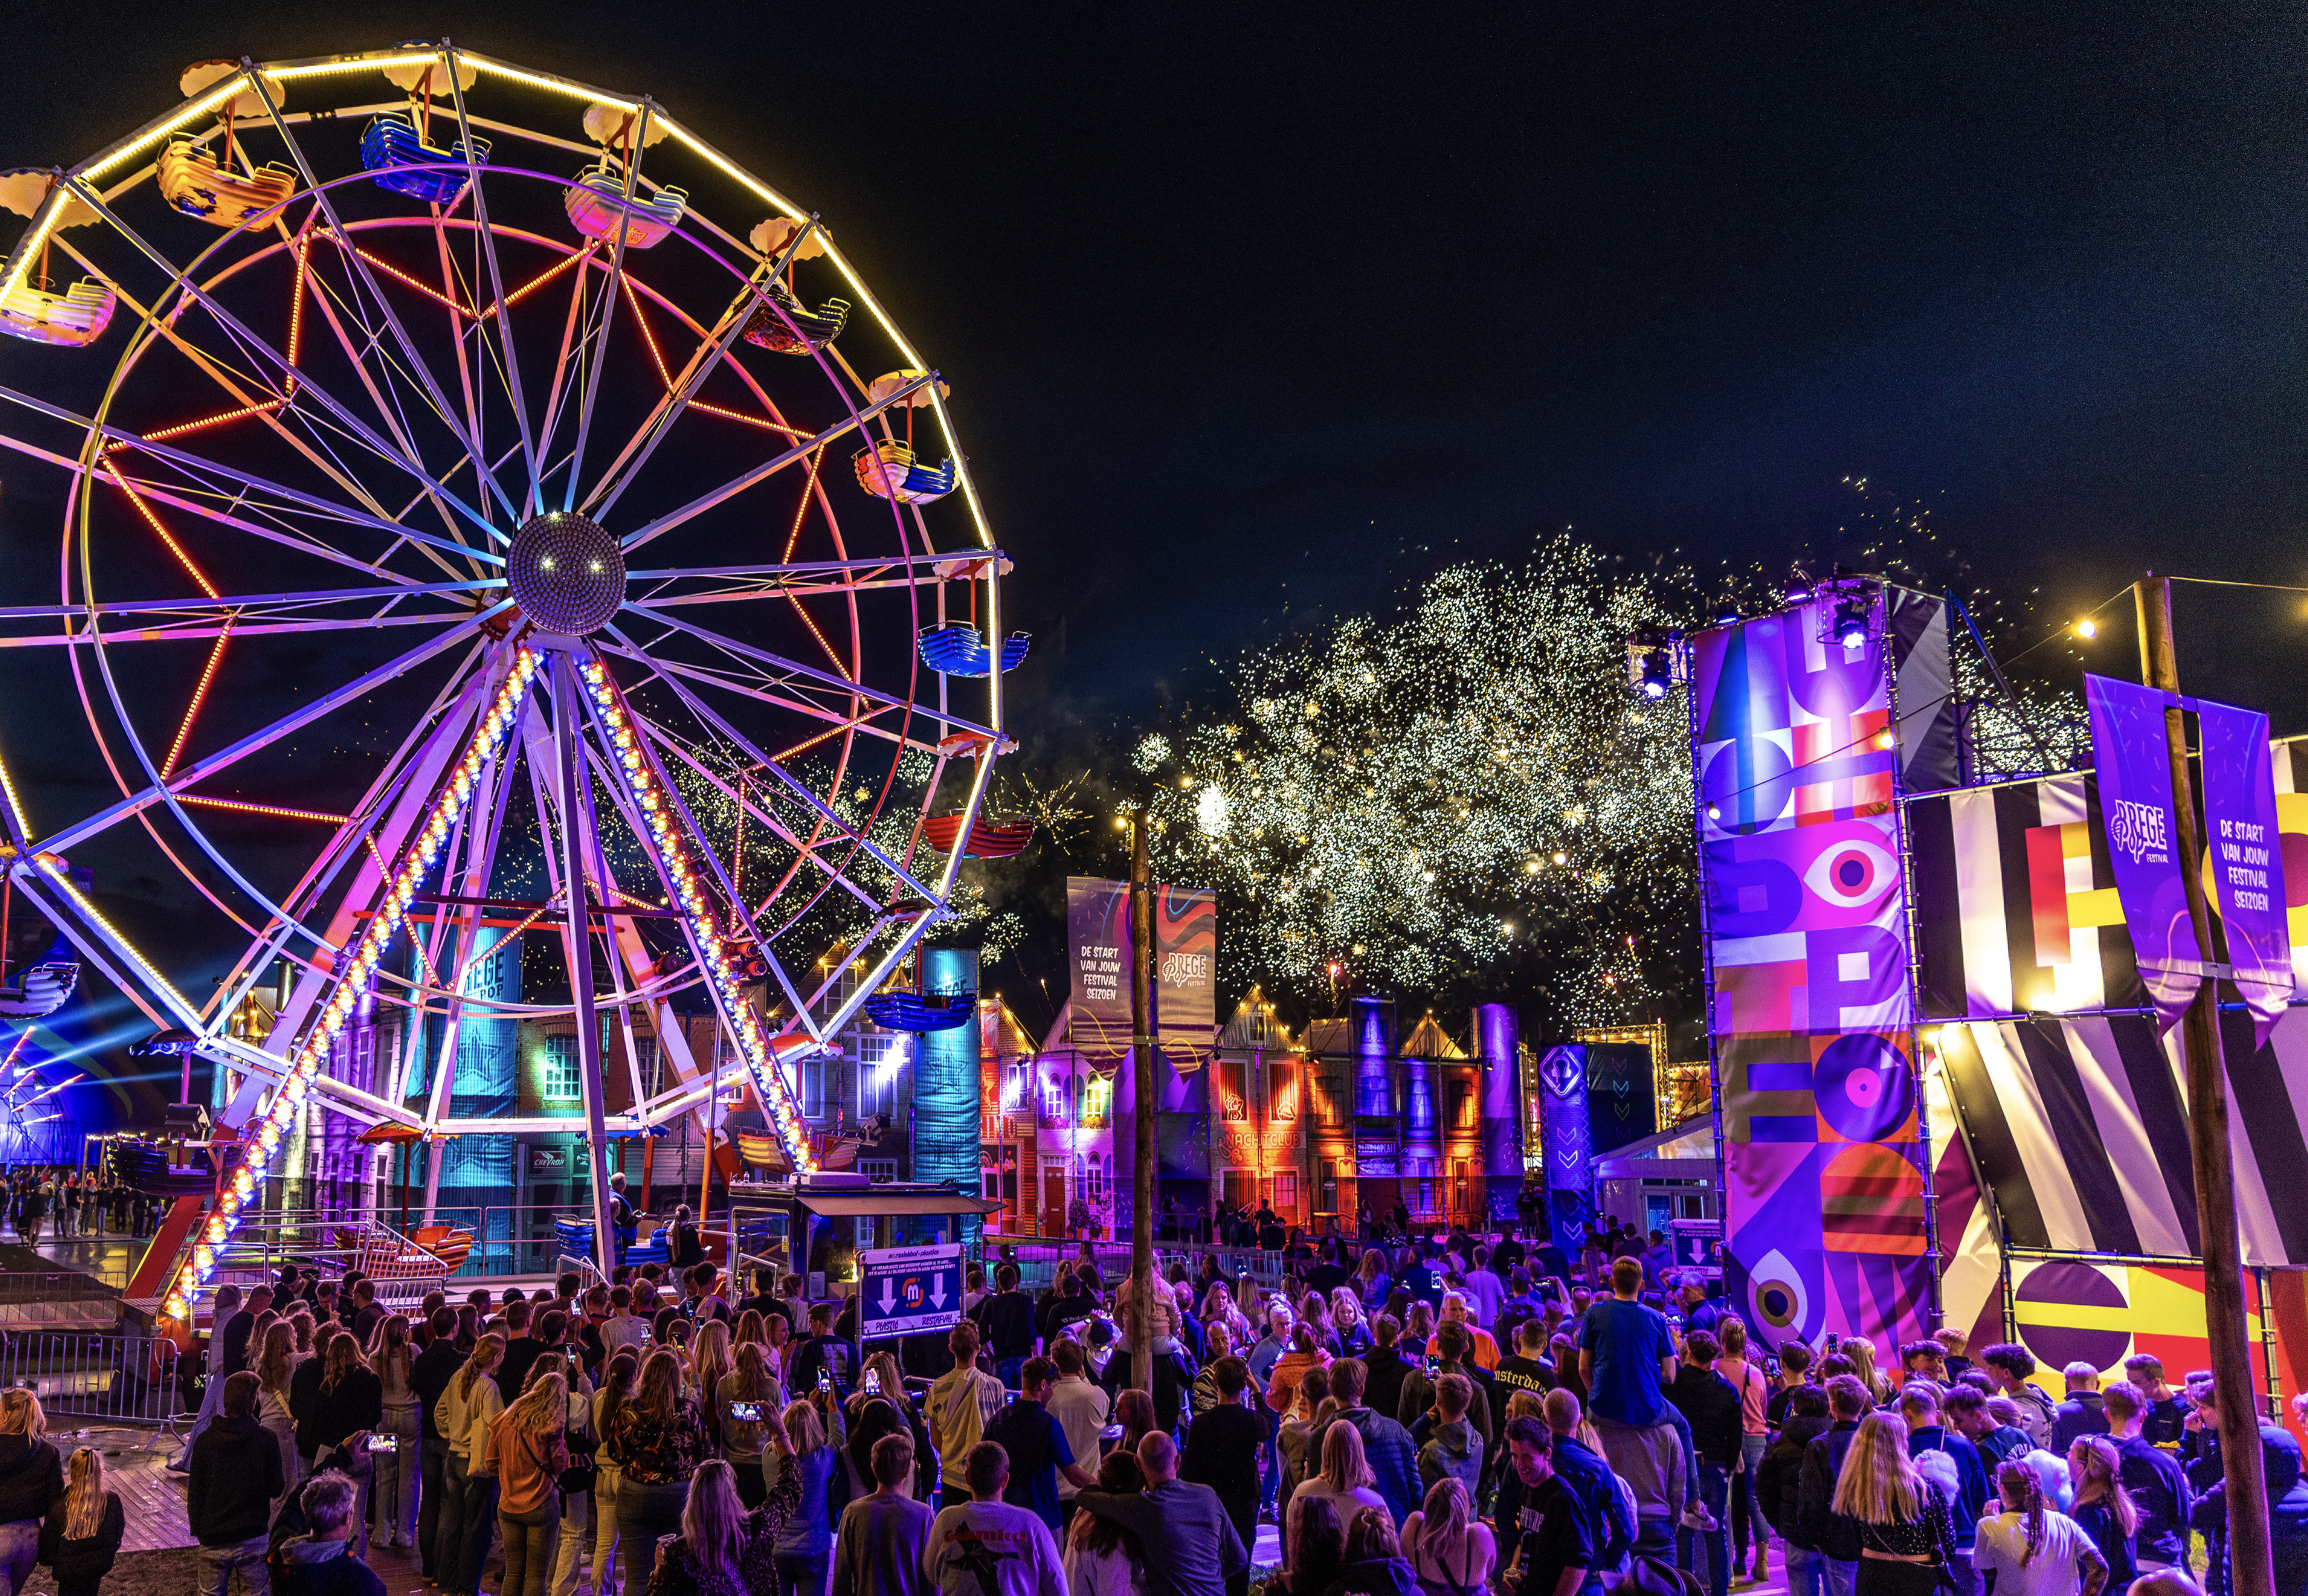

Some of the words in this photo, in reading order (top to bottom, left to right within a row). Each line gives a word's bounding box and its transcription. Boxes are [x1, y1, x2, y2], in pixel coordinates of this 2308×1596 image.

[2219, 819, 2233, 838] DE
[2234, 821, 2265, 843] START
[2146, 853, 2169, 864] FESTIVAL
[2220, 842, 2240, 863] VAN
[2242, 847, 2269, 867] JOUW
[2228, 866, 2269, 889] FESTIVAL
[2234, 889, 2269, 912] SEIZOEN
[1081, 945, 1092, 957] DE
[1093, 946, 1119, 959] START
[1080, 960, 1096, 972] VAN
[1098, 961, 1121, 973] JOUW
[1083, 973, 1118, 987] FESTIVAL
[480, 984, 504, 1000] POP
[1086, 988, 1116, 1000] SEIZOEN
[1225, 1132, 1300, 1148] NACHTCLUB
